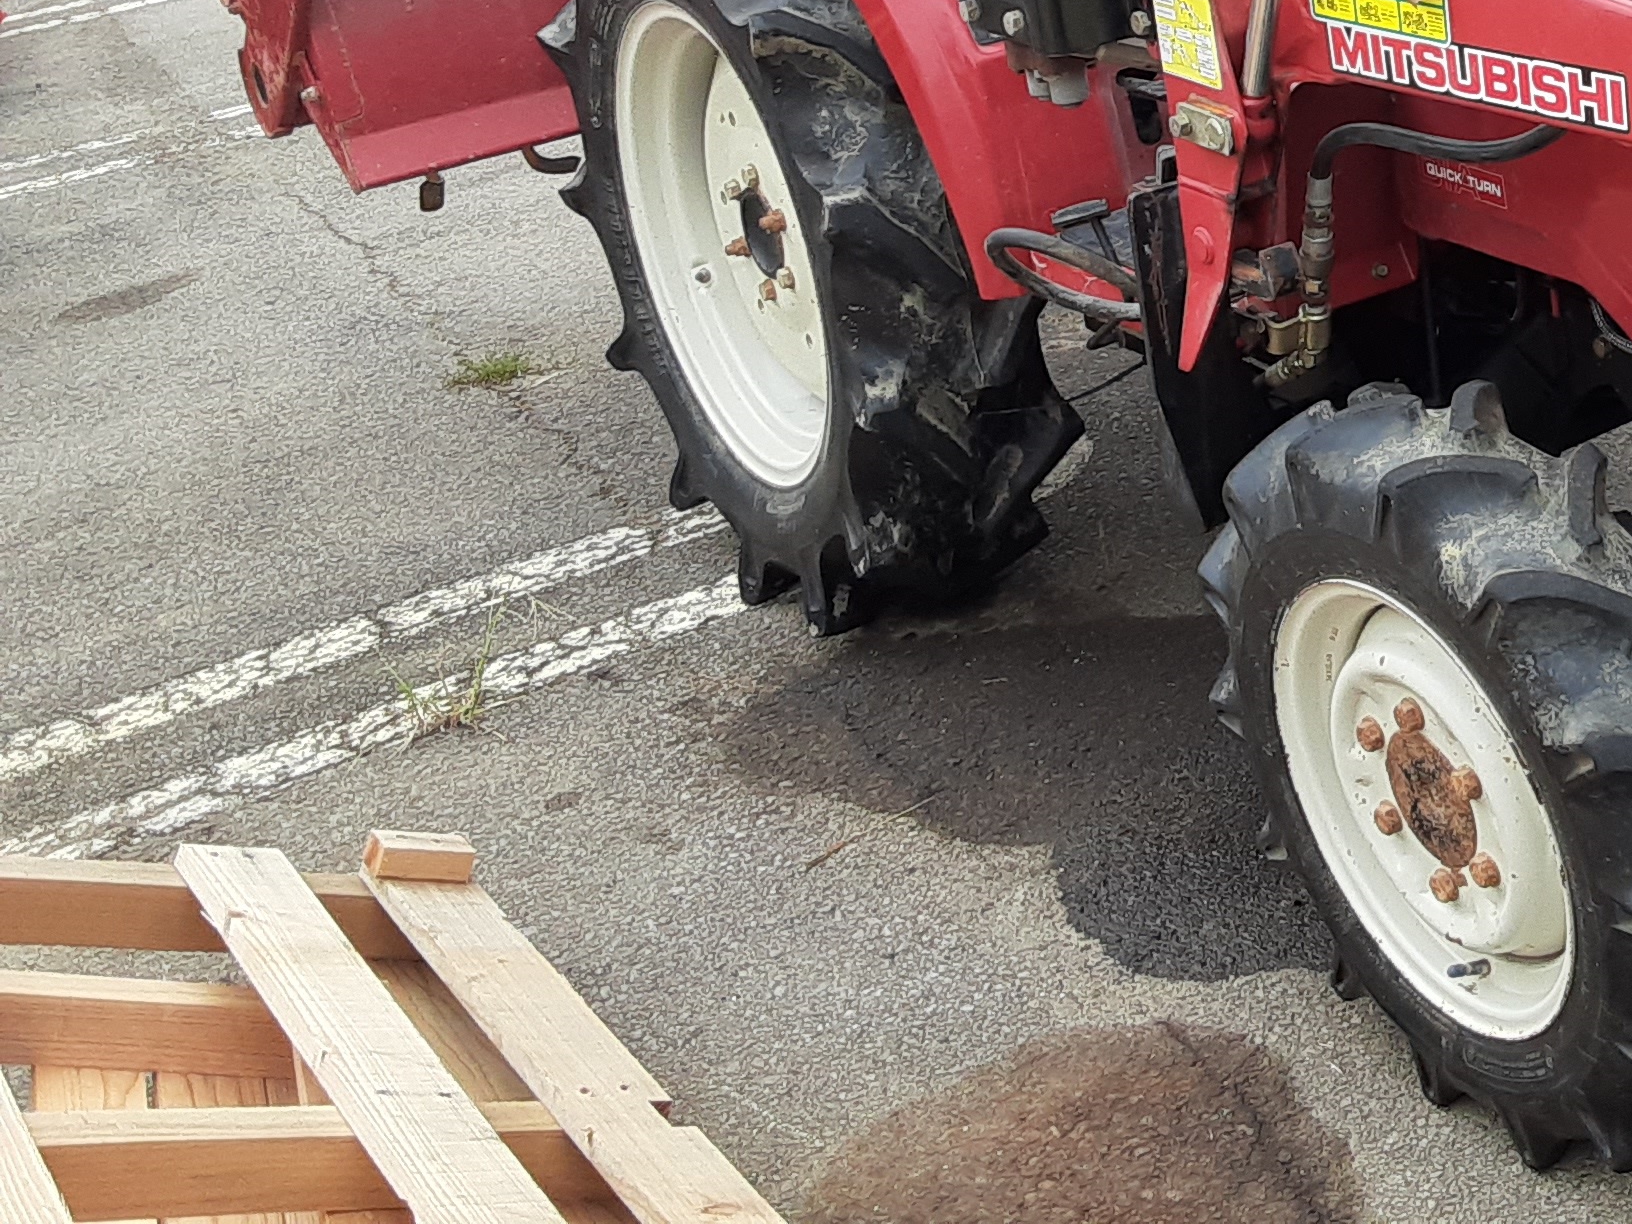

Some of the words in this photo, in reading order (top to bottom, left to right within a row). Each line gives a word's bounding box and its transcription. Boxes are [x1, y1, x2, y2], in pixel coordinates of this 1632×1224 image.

[1328, 25, 1627, 128] MITSUBISHI
[1425, 161, 1463, 186] QUICK
[1466, 174, 1503, 198] TURN
